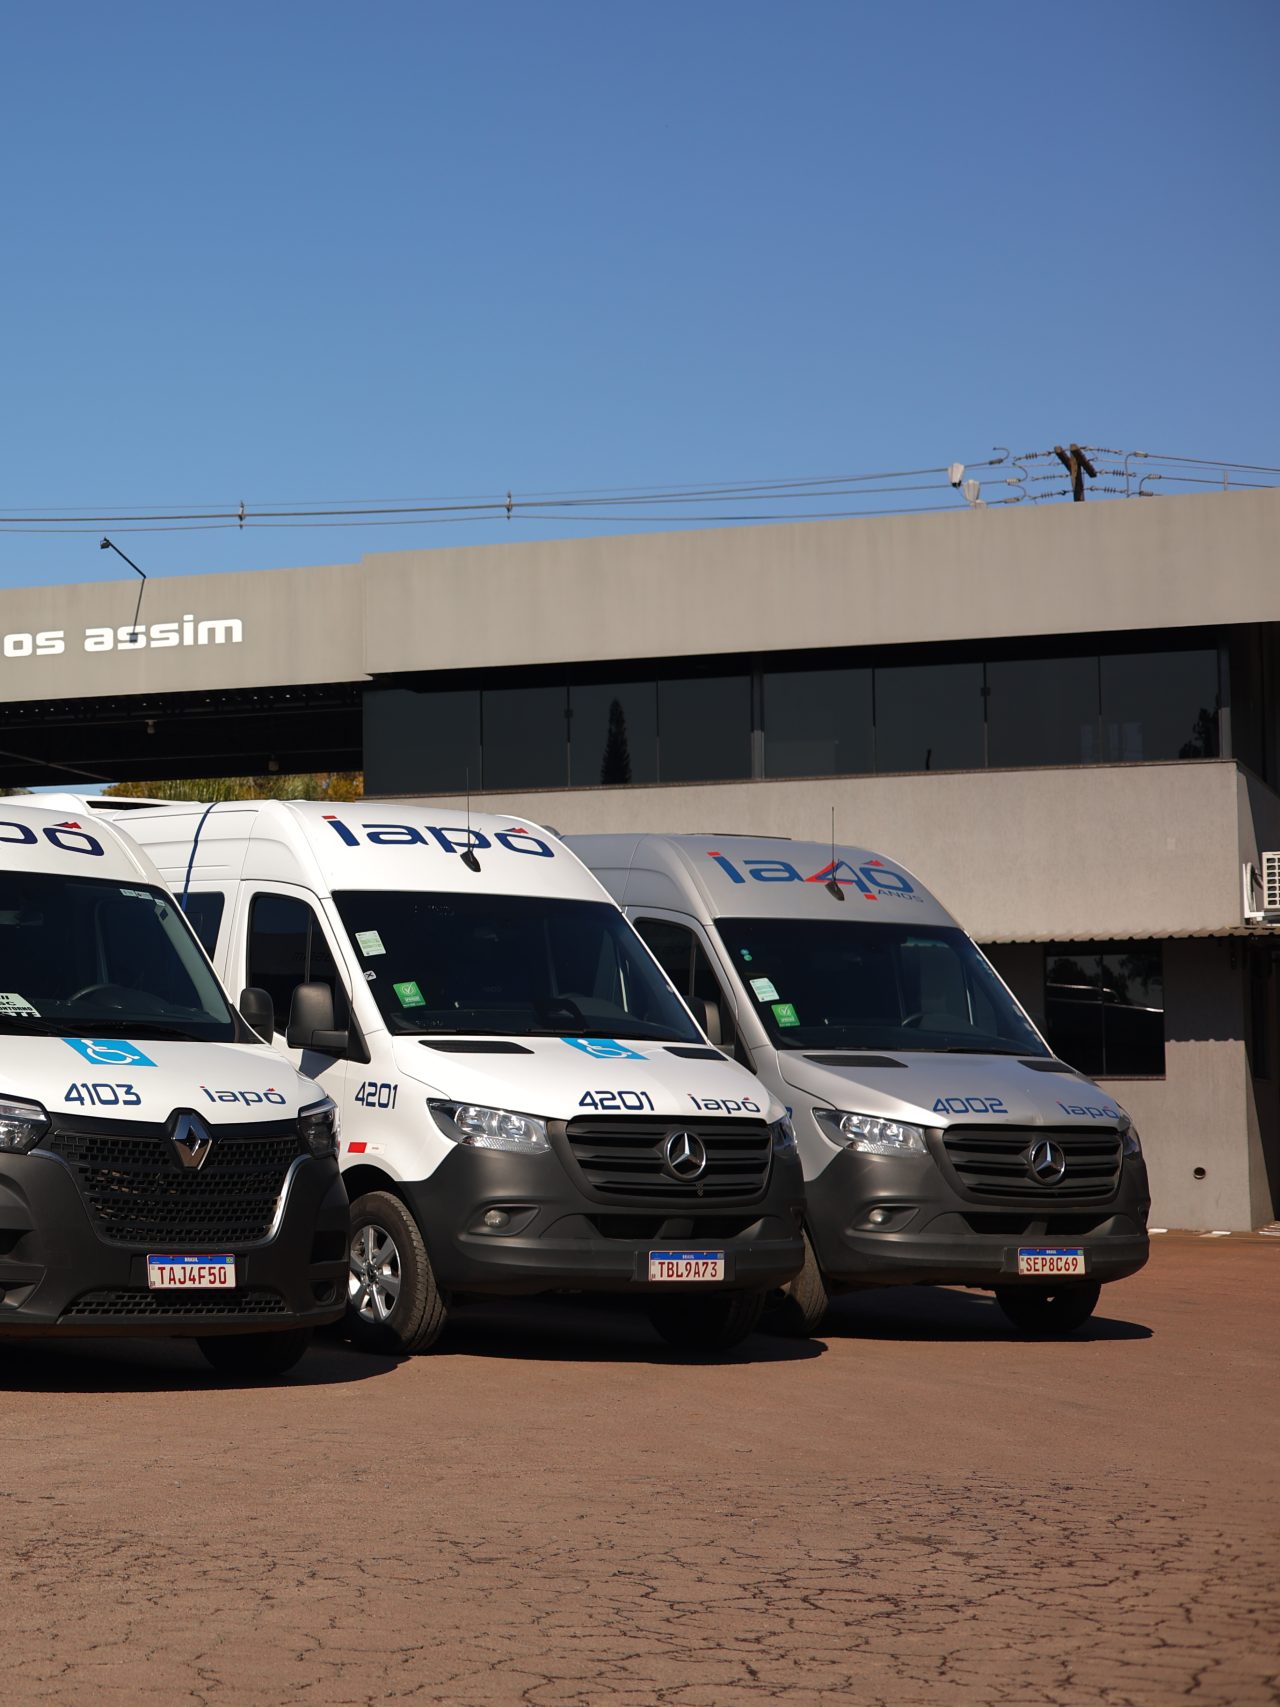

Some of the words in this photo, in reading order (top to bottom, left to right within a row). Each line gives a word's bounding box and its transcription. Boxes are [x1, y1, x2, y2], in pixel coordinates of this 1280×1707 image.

[84, 614, 243, 652] assim
[64, 1083, 142, 1106] 4103
[355, 1081, 398, 1109] 4201
[578, 1090, 655, 1111] 4201
[933, 1097, 1009, 1114] 4002
[658, 1262, 718, 1278] TBL9A73
[1026, 1257, 1078, 1272] SEP8C69
